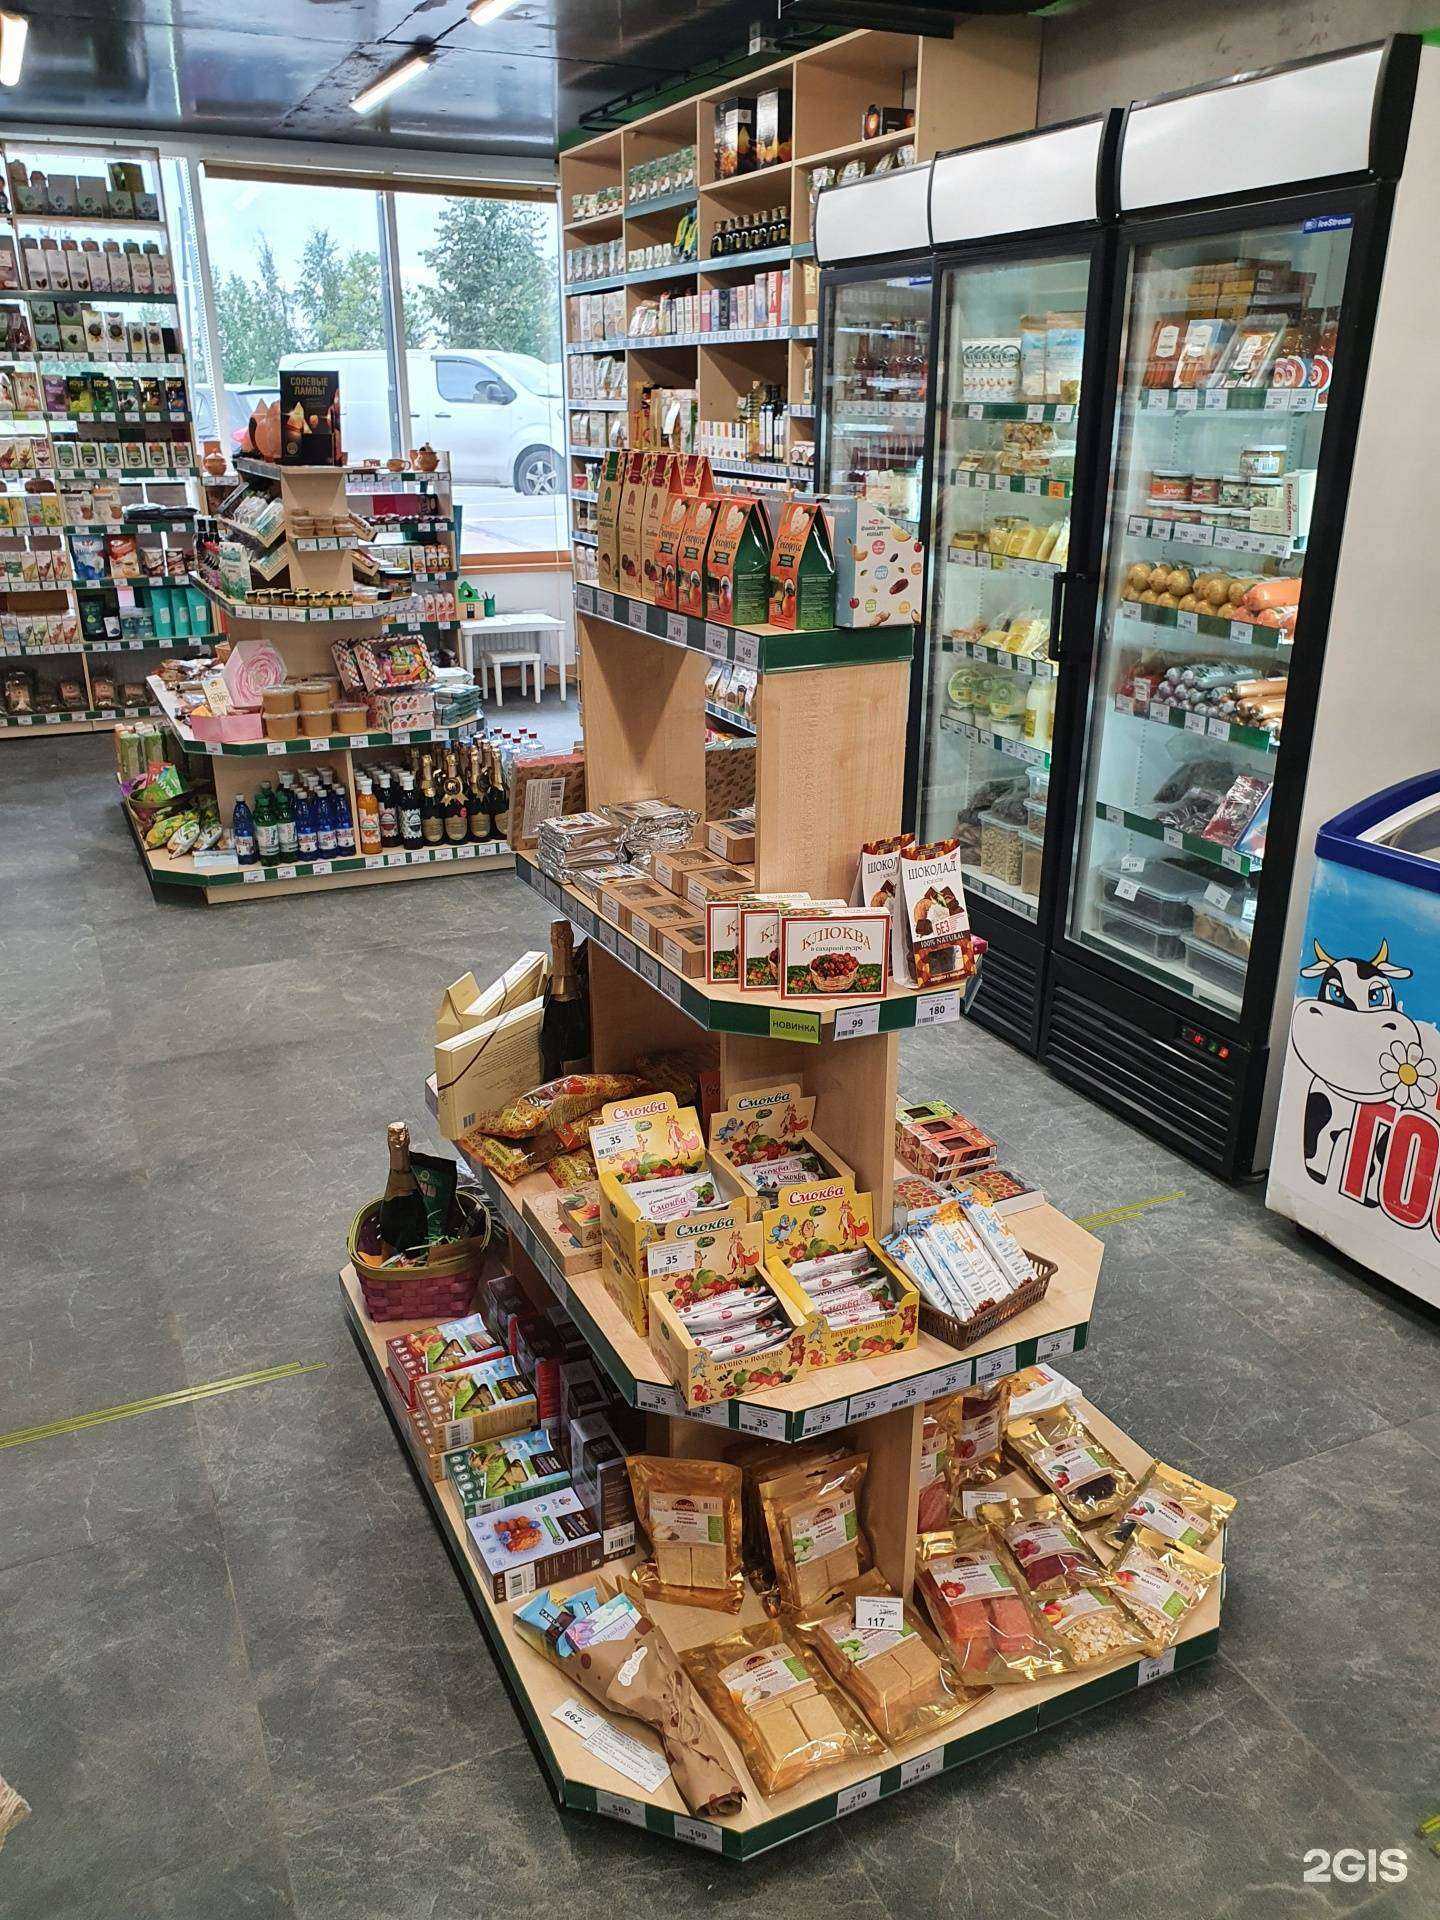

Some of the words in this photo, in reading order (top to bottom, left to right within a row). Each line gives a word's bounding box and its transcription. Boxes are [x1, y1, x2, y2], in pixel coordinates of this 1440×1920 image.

[290, 376, 329, 387] СОЛЕВЫЕ
[294, 386, 326, 395] ЛАМПЫ
[908, 861, 957, 880] ШОКОЛАД
[935, 920, 950, 936] БЕЗ
[801, 926, 872, 951] КЛЮКВА
[816, 945, 844, 953] сахарной
[928, 1006, 945, 1016] 180
[772, 1019, 817, 1034] НОВИНКА
[851, 1019, 864, 1028] 99
[739, 1091, 791, 1109] Смоква
[612, 1101, 668, 1120] Смоква
[609, 1135, 621, 1145] 35
[1340, 1102, 1440, 1240] ГО
[789, 1186, 845, 1204] Смоква
[650, 1196, 688, 1213] Смоква
[676, 1217, 735, 1236] Смоква
[665, 1255, 678, 1265] 35
[991, 1362, 1002, 1371] 25
[946, 1376, 957, 1386] 25
[905, 1389, 917, 1398] 35
[654, 1396, 667, 1405] 35
[865, 1401, 876, 1410] 35
[700, 1405, 712, 1414] 35
[757, 1419, 769, 1428] 35
[820, 1415, 831, 1423] 35
[867, 1617, 886, 1627] 117
[564, 1710, 582, 1725] 662
